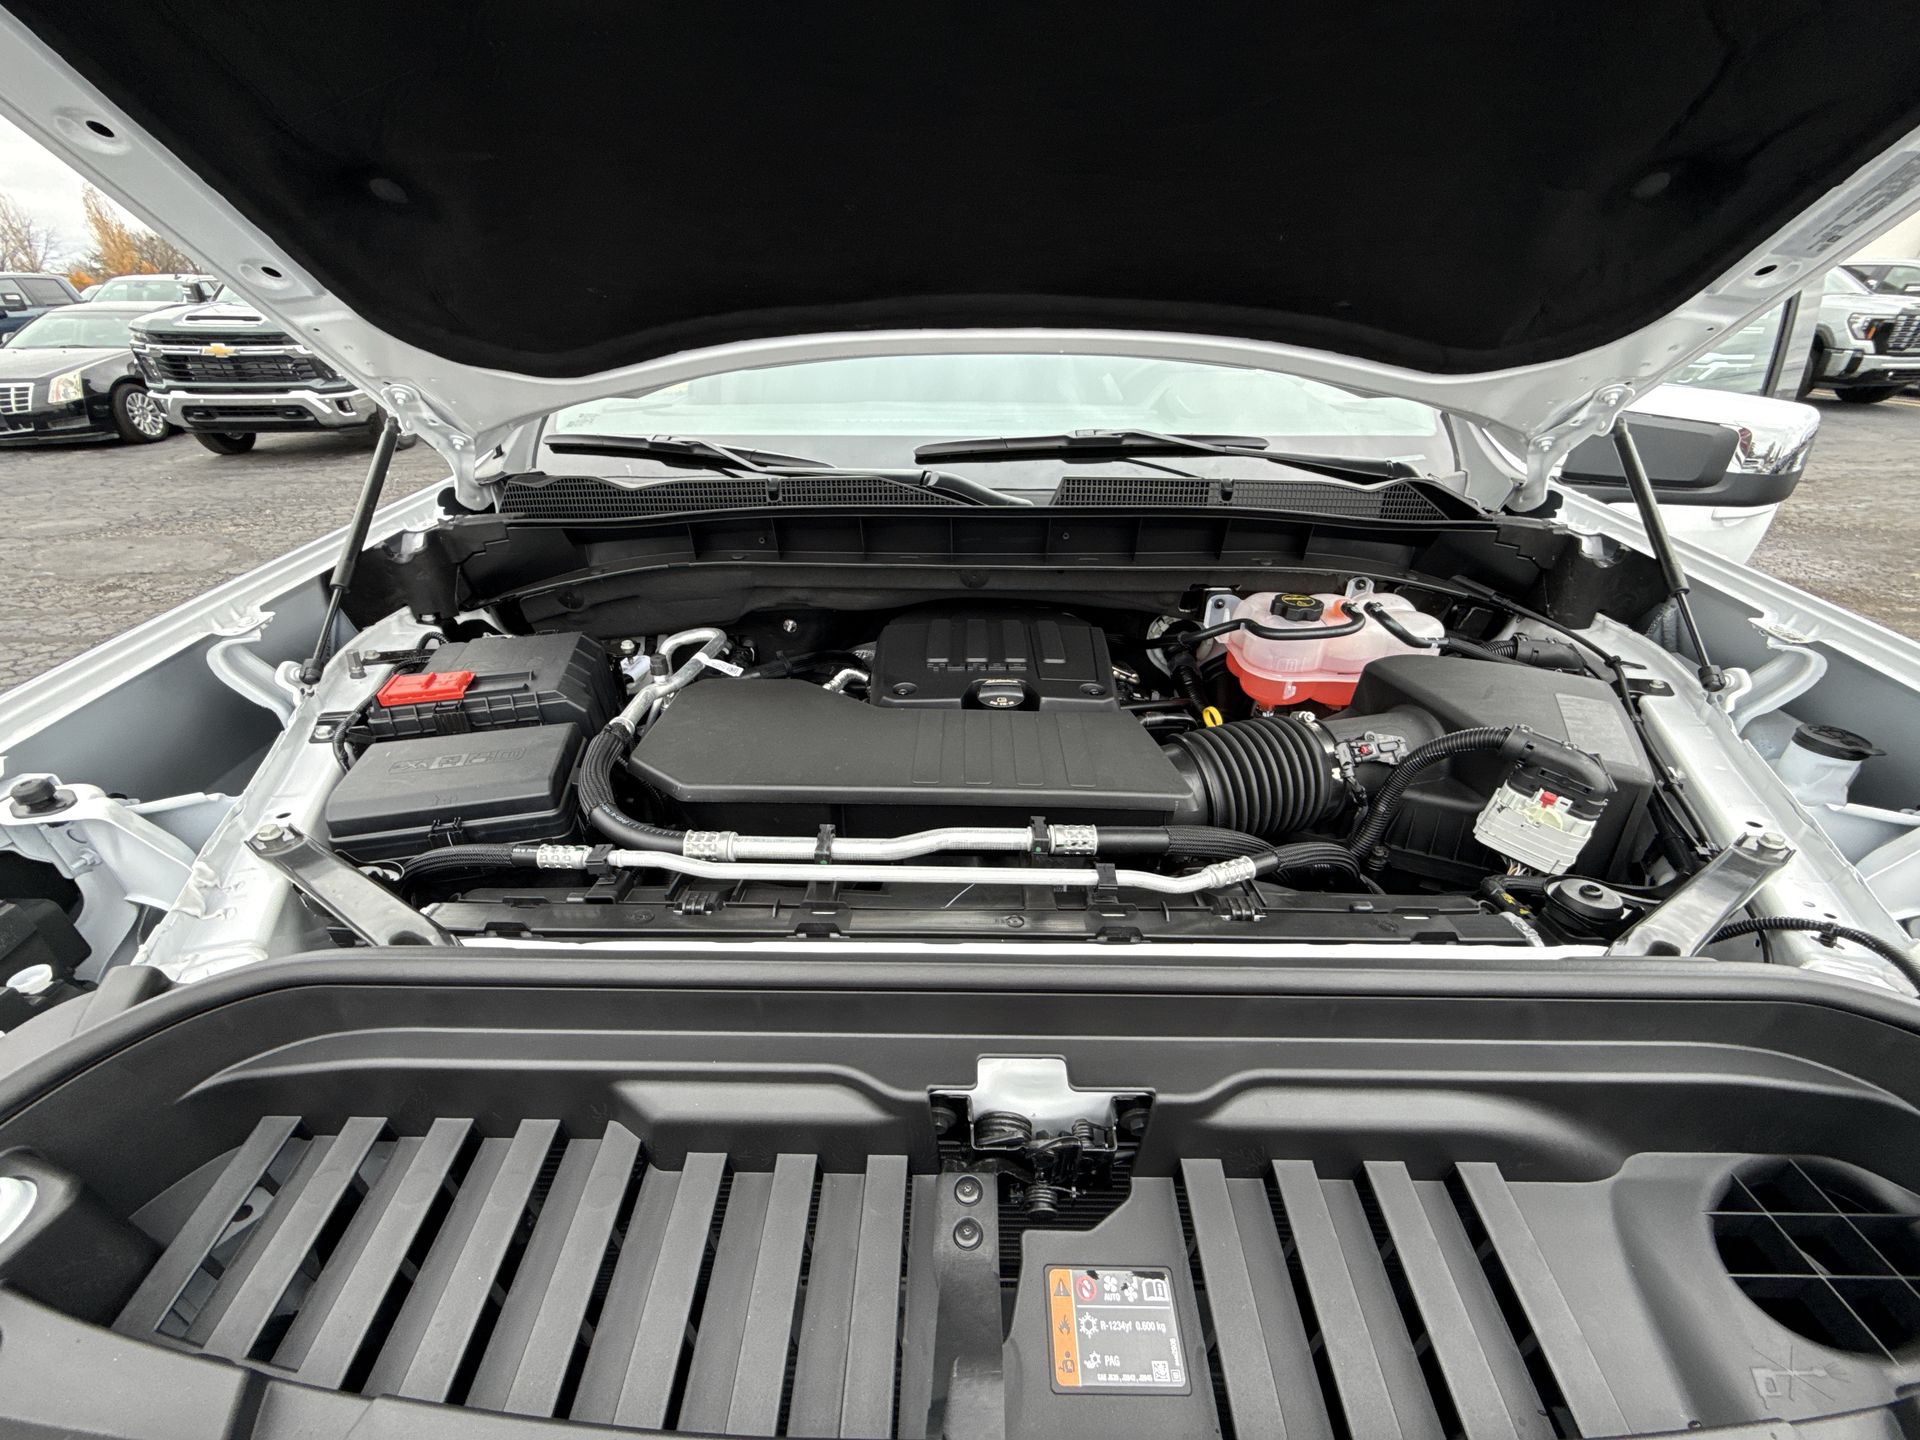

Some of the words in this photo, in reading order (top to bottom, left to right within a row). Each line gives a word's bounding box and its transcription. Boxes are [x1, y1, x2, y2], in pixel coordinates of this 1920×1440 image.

[1104, 1292, 1121, 1302] AUTO
[1156, 1320, 1167, 1334] kg
[1104, 1354, 1121, 1367] PAG
